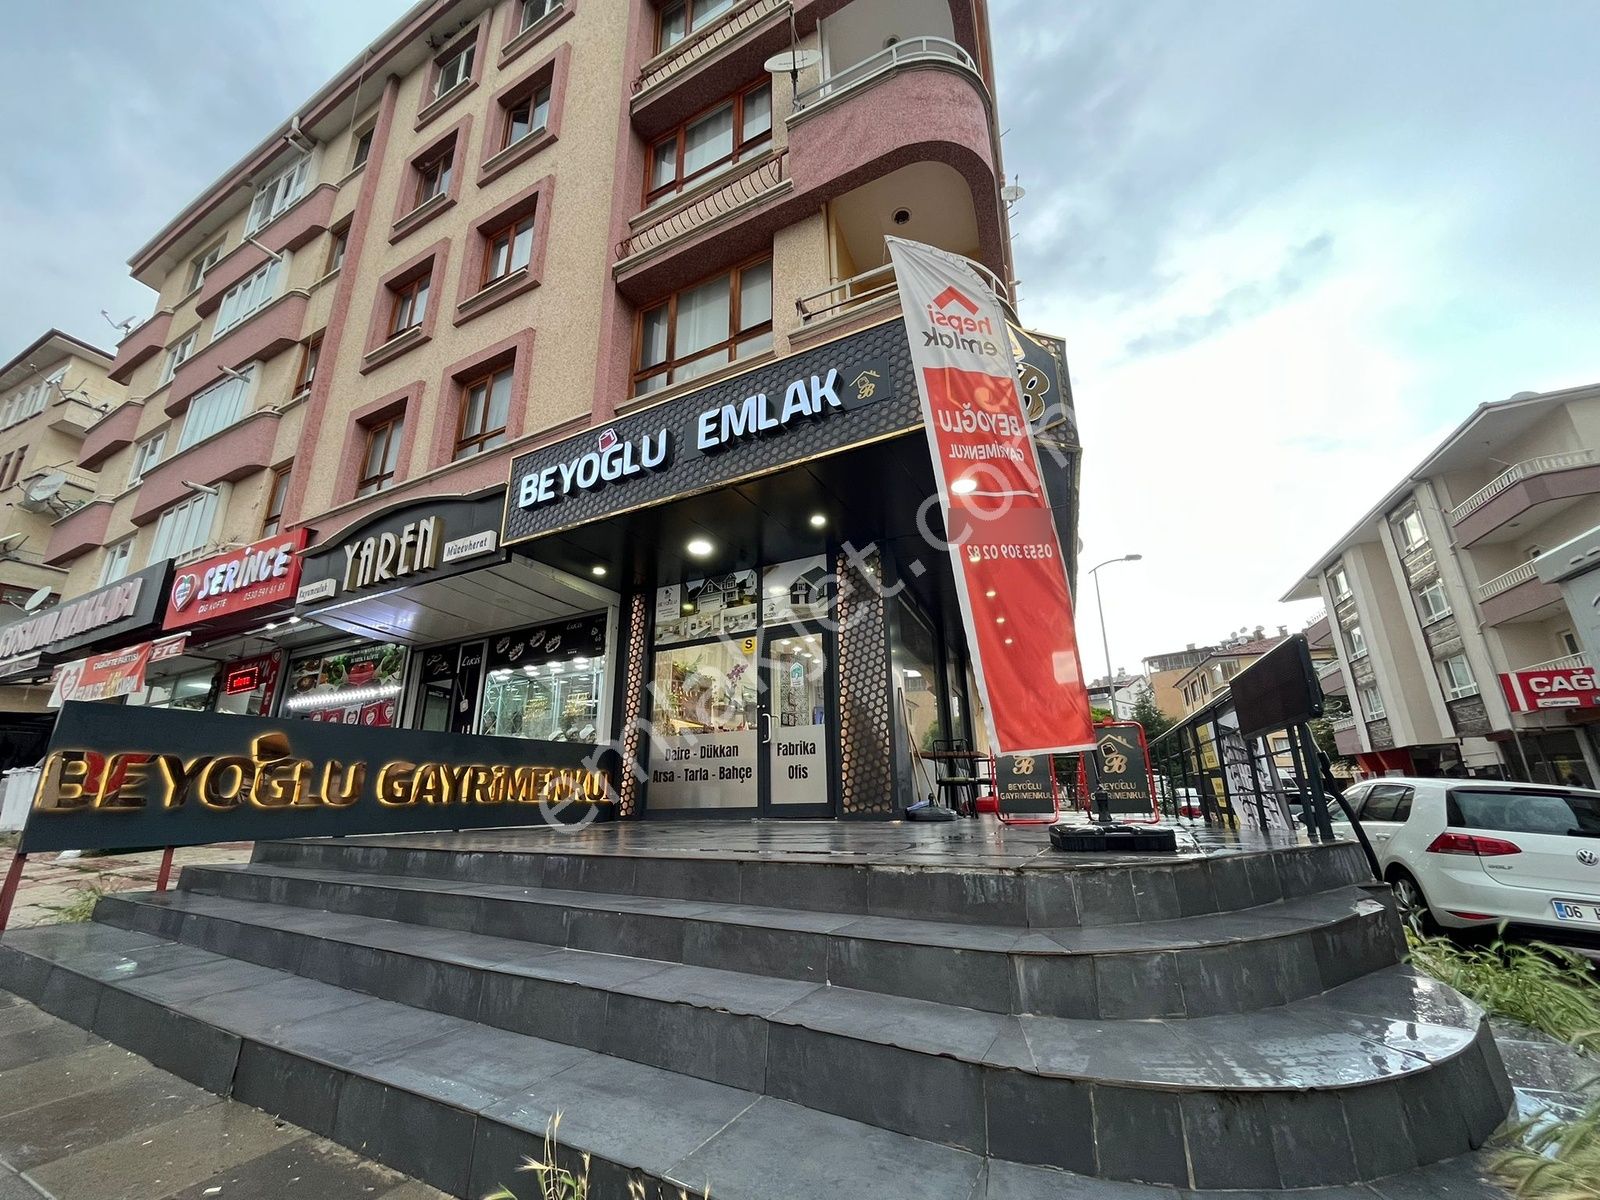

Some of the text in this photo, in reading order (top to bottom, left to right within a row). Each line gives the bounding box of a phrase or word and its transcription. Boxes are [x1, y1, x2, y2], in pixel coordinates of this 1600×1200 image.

[697, 368, 841, 450] EMLAK
[342, 515, 436, 592] YAREN
[744, 638, 753, 650] S
[700, 745, 739, 759] Dükkan
[777, 741, 816, 757] Fabrika
[652, 769, 675, 783] Arsa
[684, 767, 709, 782] Tarla
[719, 766, 752, 783] Bahçe
[788, 764, 808, 779] Ofis
[1564, 905, 1584, 919] 06
